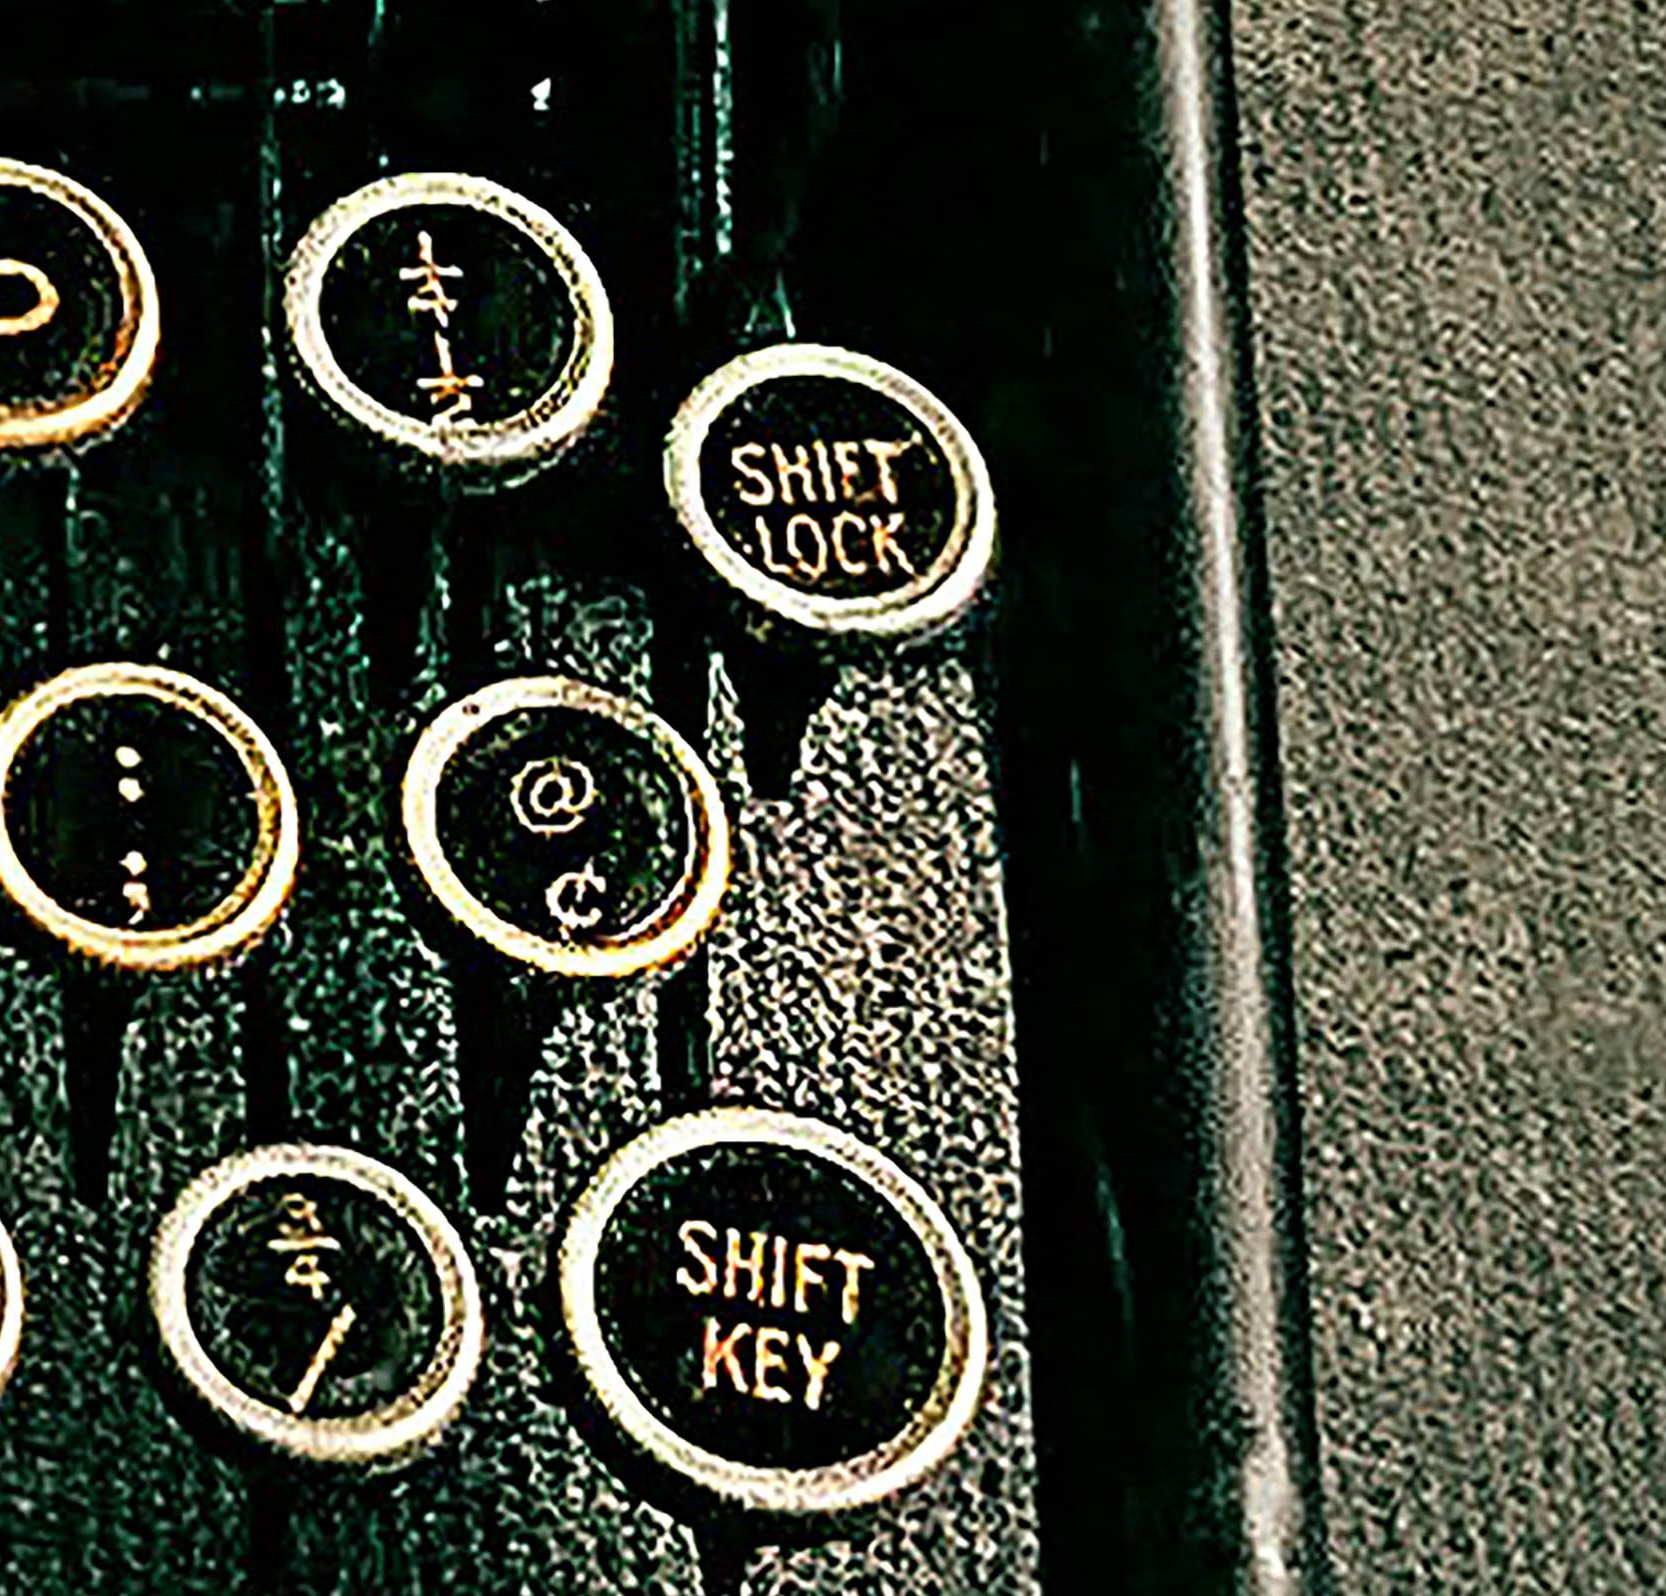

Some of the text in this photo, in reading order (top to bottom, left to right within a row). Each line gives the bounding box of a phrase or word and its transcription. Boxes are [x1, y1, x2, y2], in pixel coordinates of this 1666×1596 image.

[732, 437, 911, 502] SHIFT
[757, 512, 912, 575] LOCK
[510, 757, 598, 834] @
[677, 1220, 874, 1318] SHIFT
[702, 1317, 840, 1410] KEY
